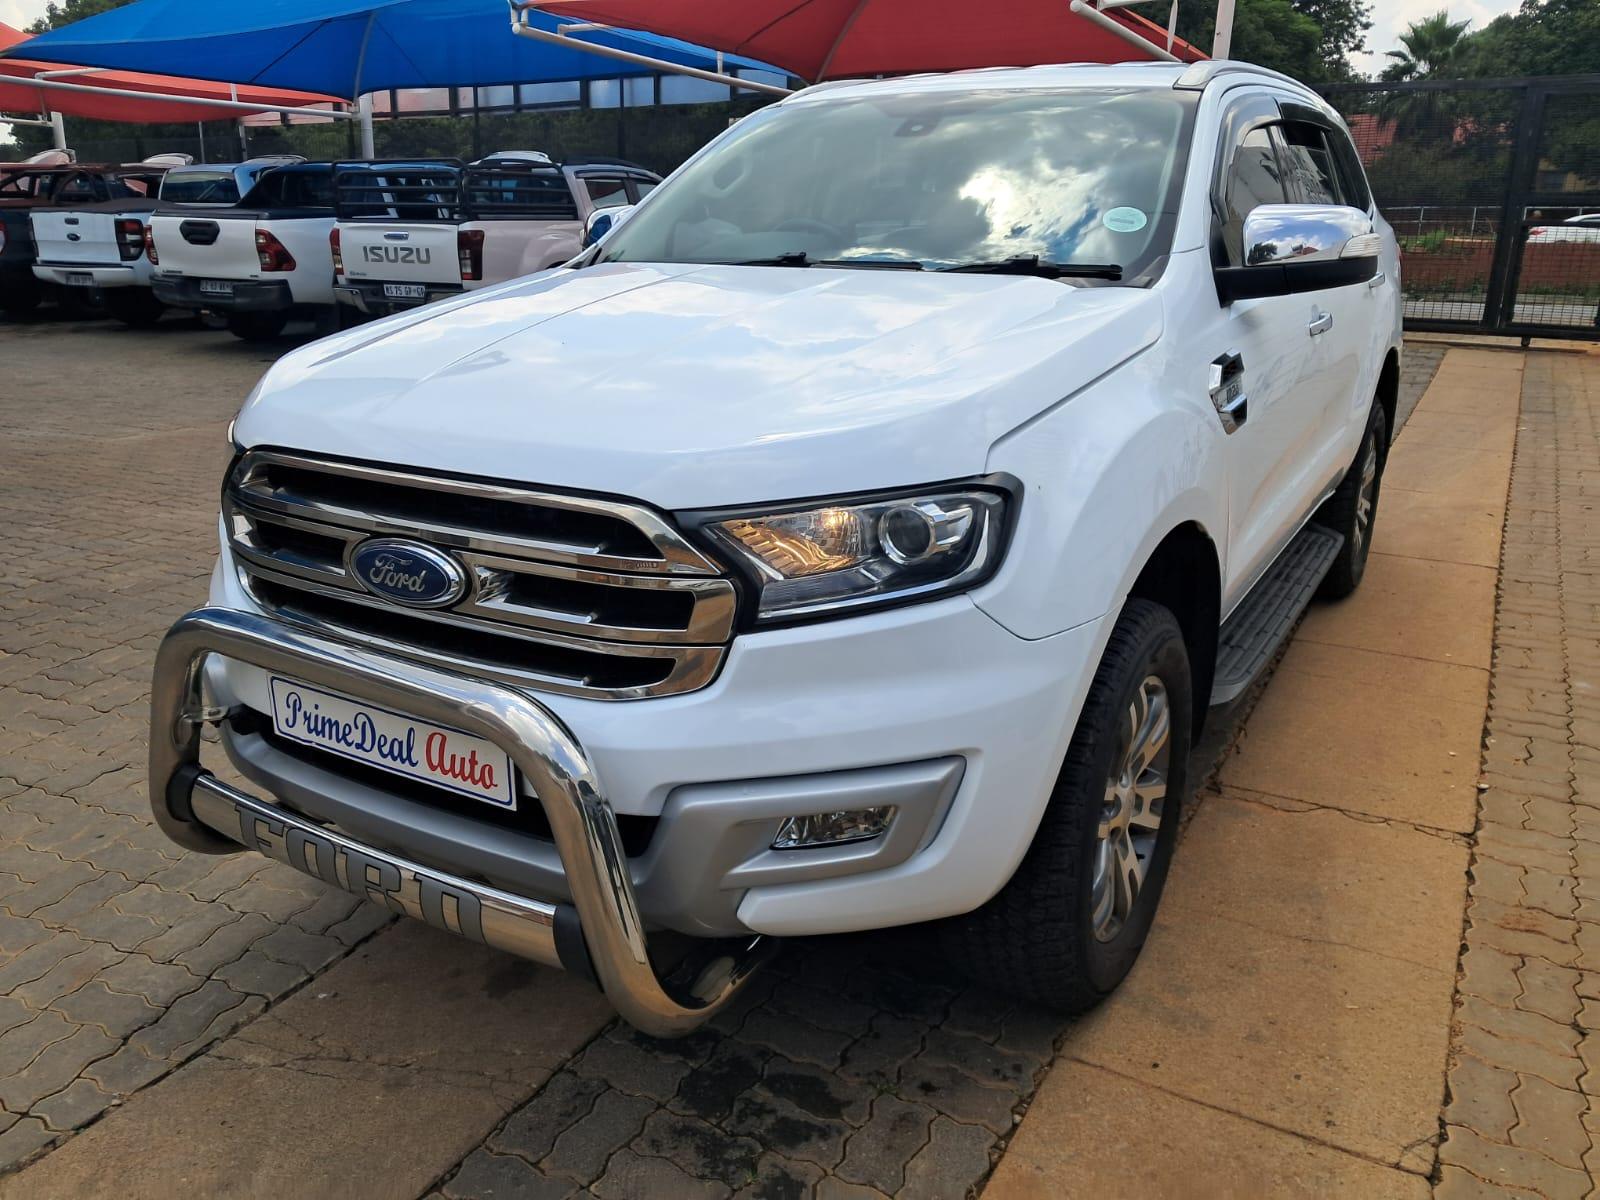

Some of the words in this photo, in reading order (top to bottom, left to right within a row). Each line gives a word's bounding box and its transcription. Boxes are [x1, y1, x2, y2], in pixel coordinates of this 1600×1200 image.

[362, 245, 431, 264] ISUZU
[369, 552, 426, 593] Ford
[284, 691, 419, 768] PrimeDeal
[425, 731, 498, 790] Auto
[235, 802, 488, 945] FORD
